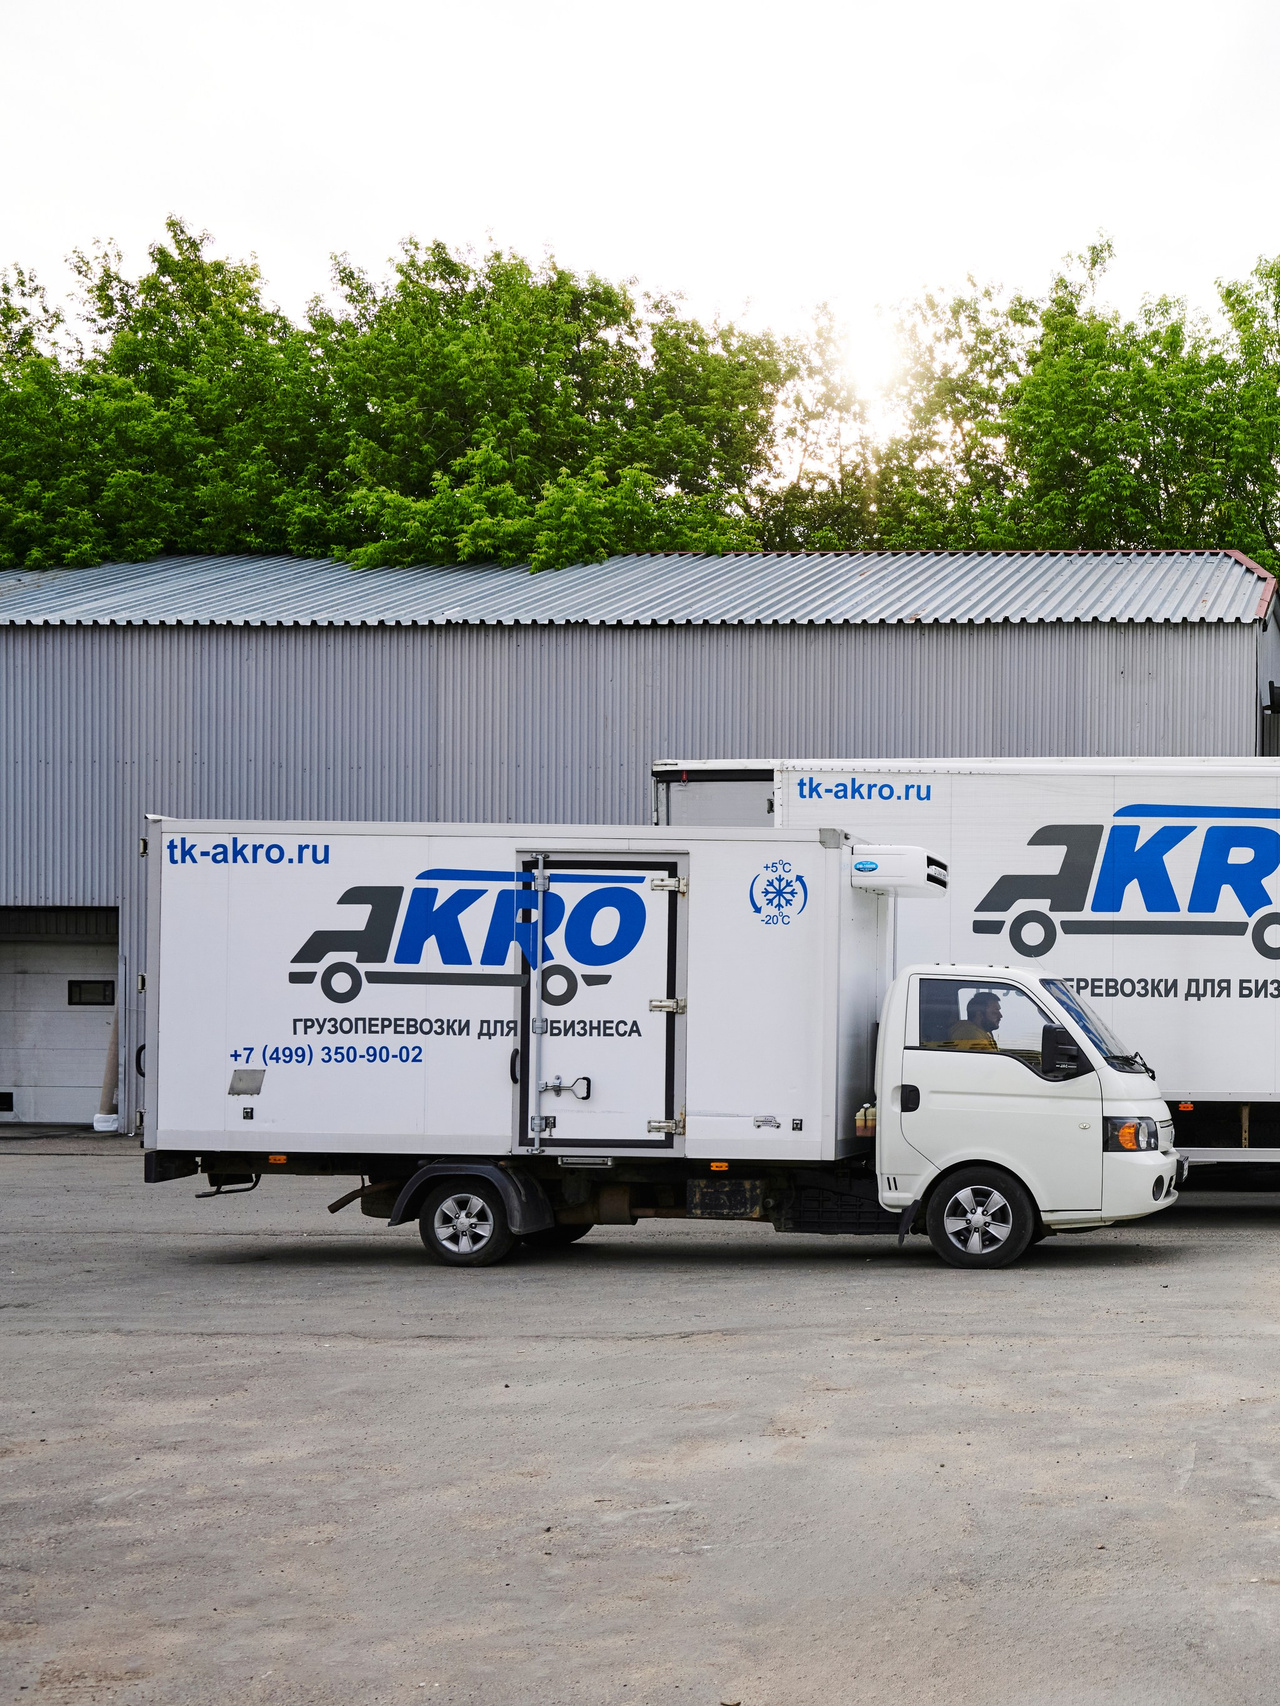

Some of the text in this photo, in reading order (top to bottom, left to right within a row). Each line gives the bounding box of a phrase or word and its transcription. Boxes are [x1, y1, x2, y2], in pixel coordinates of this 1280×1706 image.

[797, 776, 932, 802] tk-akro.ru
[166, 835, 330, 865] tk-akro.ru
[1185, 979, 1232, 1002] ДЛЯ
[293, 1018, 642, 1040] ГРУЗОПЕРЕВОЗКИ ДЛЯ БИЗНЕСА
[230, 1043, 424, 1067] +7 (499) 350-90-02
